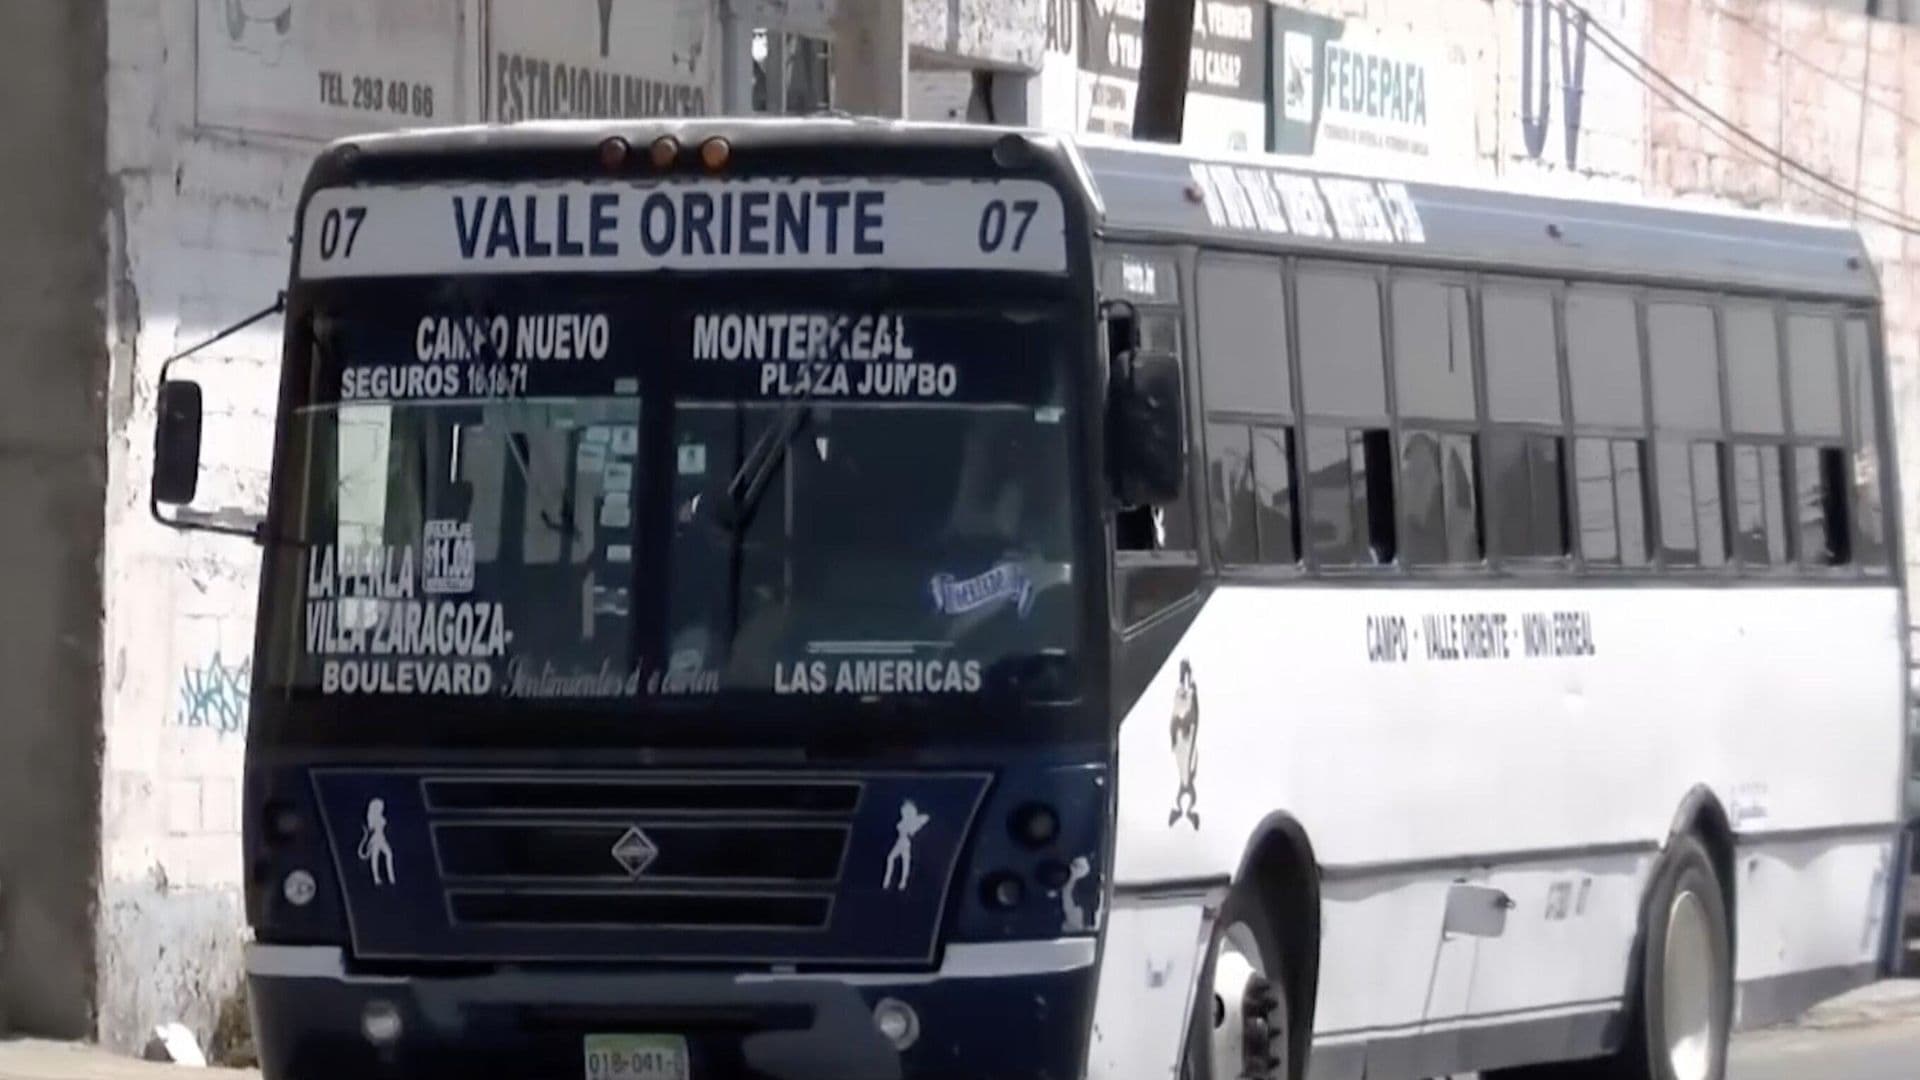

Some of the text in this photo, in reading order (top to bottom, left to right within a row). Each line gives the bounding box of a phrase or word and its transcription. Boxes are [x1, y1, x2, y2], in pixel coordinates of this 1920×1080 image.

[1205, 50, 1242, 88] CASA?
[1326, 46, 1427, 128] FEDEPAFA
[352, 74, 384, 111] 293
[387, 79, 409, 114] 40
[412, 83, 434, 119] 66
[319, 207, 366, 260] 07
[452, 191, 885, 259] VALLE ORIENTE
[977, 200, 1039, 254] 07
[515, 314, 609, 360] NUEVO
[341, 364, 460, 398] SEGUROS
[760, 363, 957, 397] PLAZA JUMBO
[308, 545, 334, 598] LA
[306, 600, 368, 655] VILLA
[1366, 614, 1408, 662] CAMPO
[1423, 613, 1460, 661] VALLE
[1460, 612, 1510, 659] ORIENTE
[322, 661, 492, 695] BOULEVARD
[774, 660, 982, 694] LAS AMERICAS
